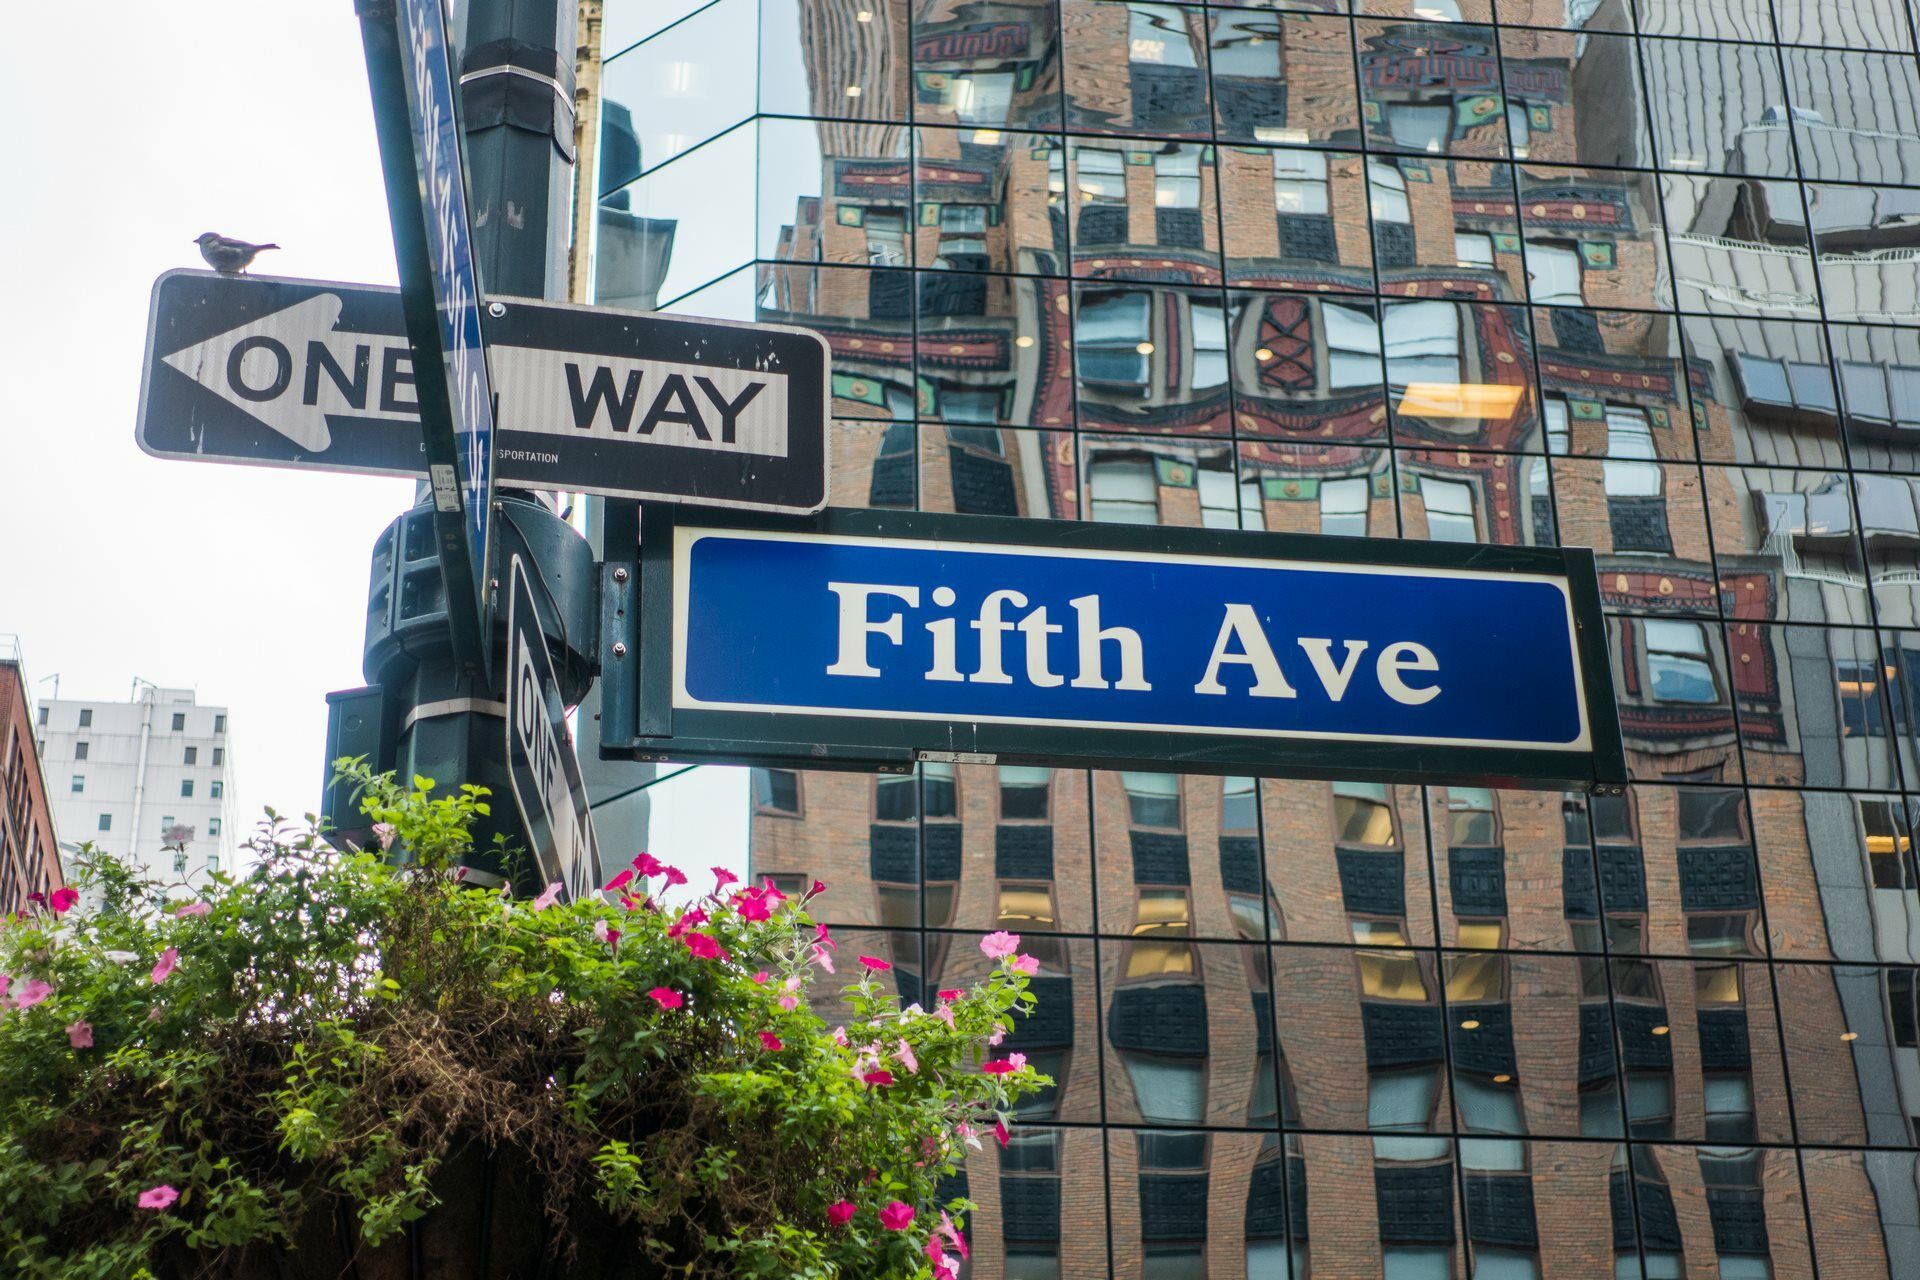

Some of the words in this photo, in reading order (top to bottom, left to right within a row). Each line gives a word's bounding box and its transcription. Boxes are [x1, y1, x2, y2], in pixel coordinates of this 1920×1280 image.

[226, 335, 421, 415] ONE
[564, 362, 768, 445] WAY
[469, 370, 484, 533] St
[498, 449, 559, 464] SPORTATION
[826, 581, 1153, 692] Fifth
[1194, 603, 1443, 706] Ave
[522, 664, 557, 832] ONE
